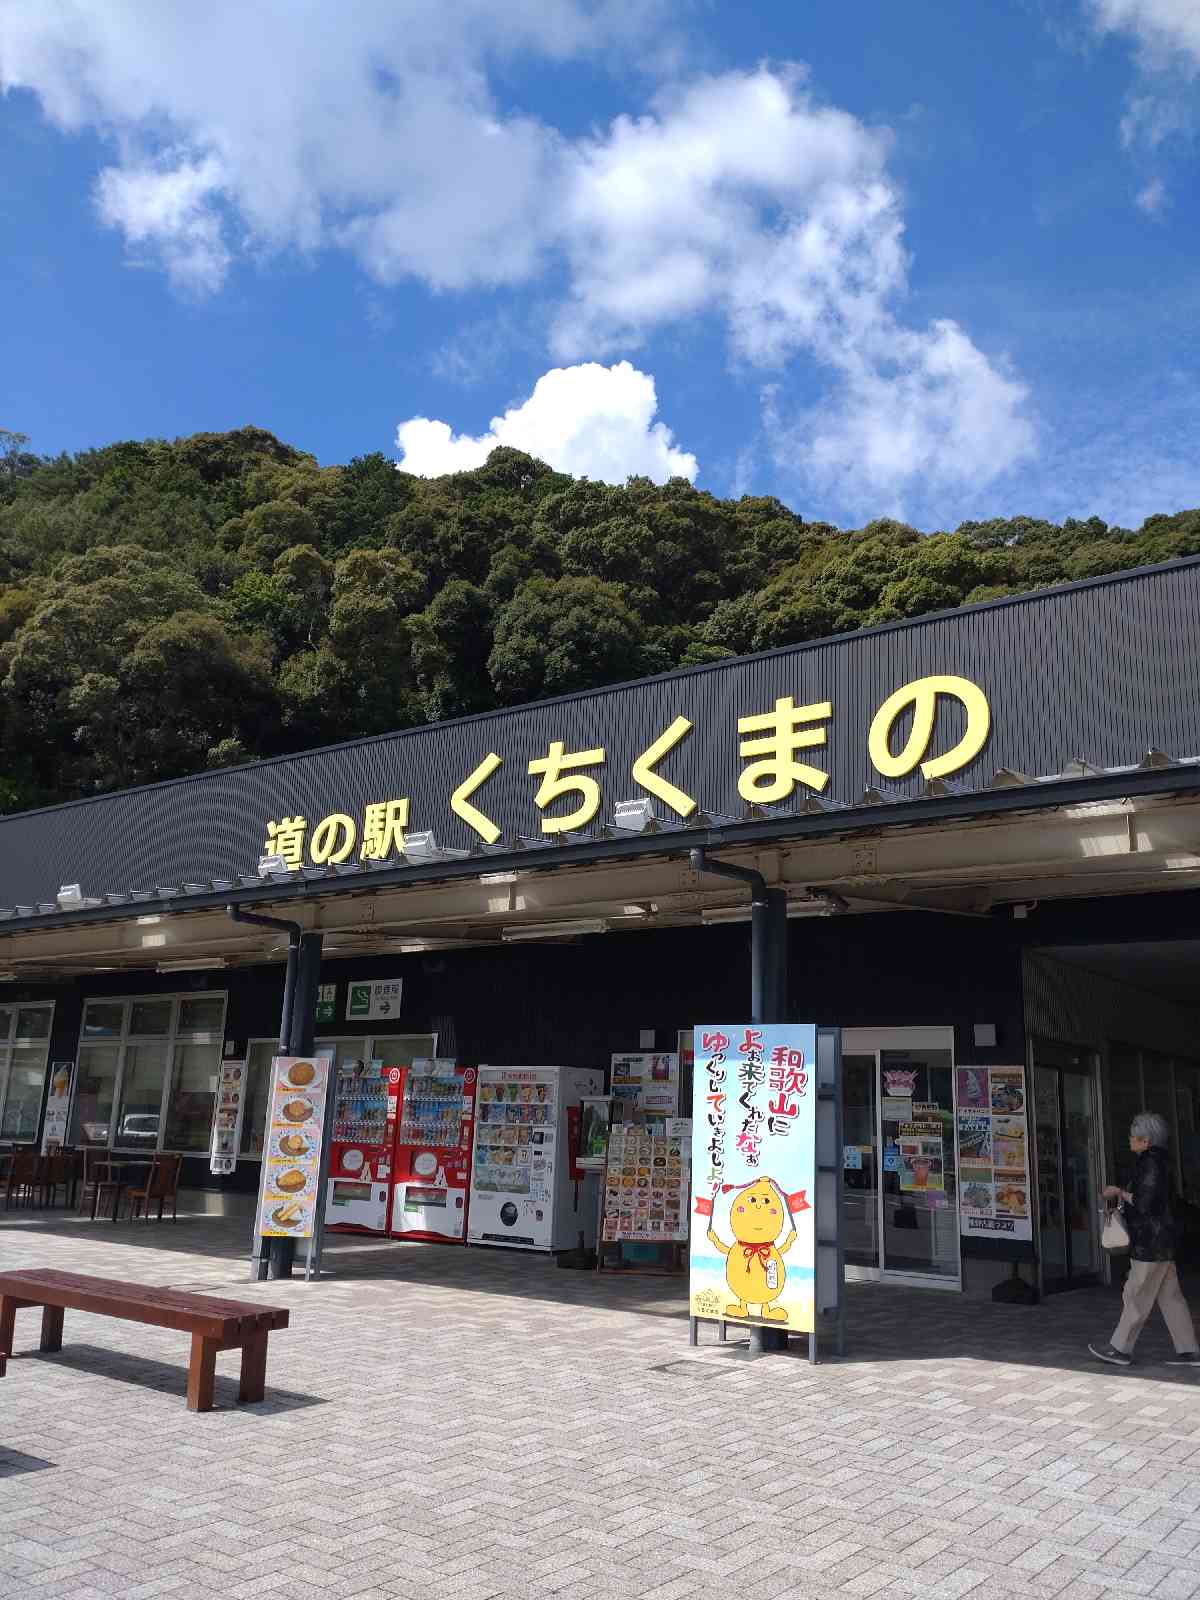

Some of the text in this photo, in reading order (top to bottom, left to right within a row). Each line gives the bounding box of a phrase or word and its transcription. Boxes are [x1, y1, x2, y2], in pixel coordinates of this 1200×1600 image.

[264, 674, 991, 872] 道の駅 くちくまの
[767, 1045, 807, 1136] 和歌山に
